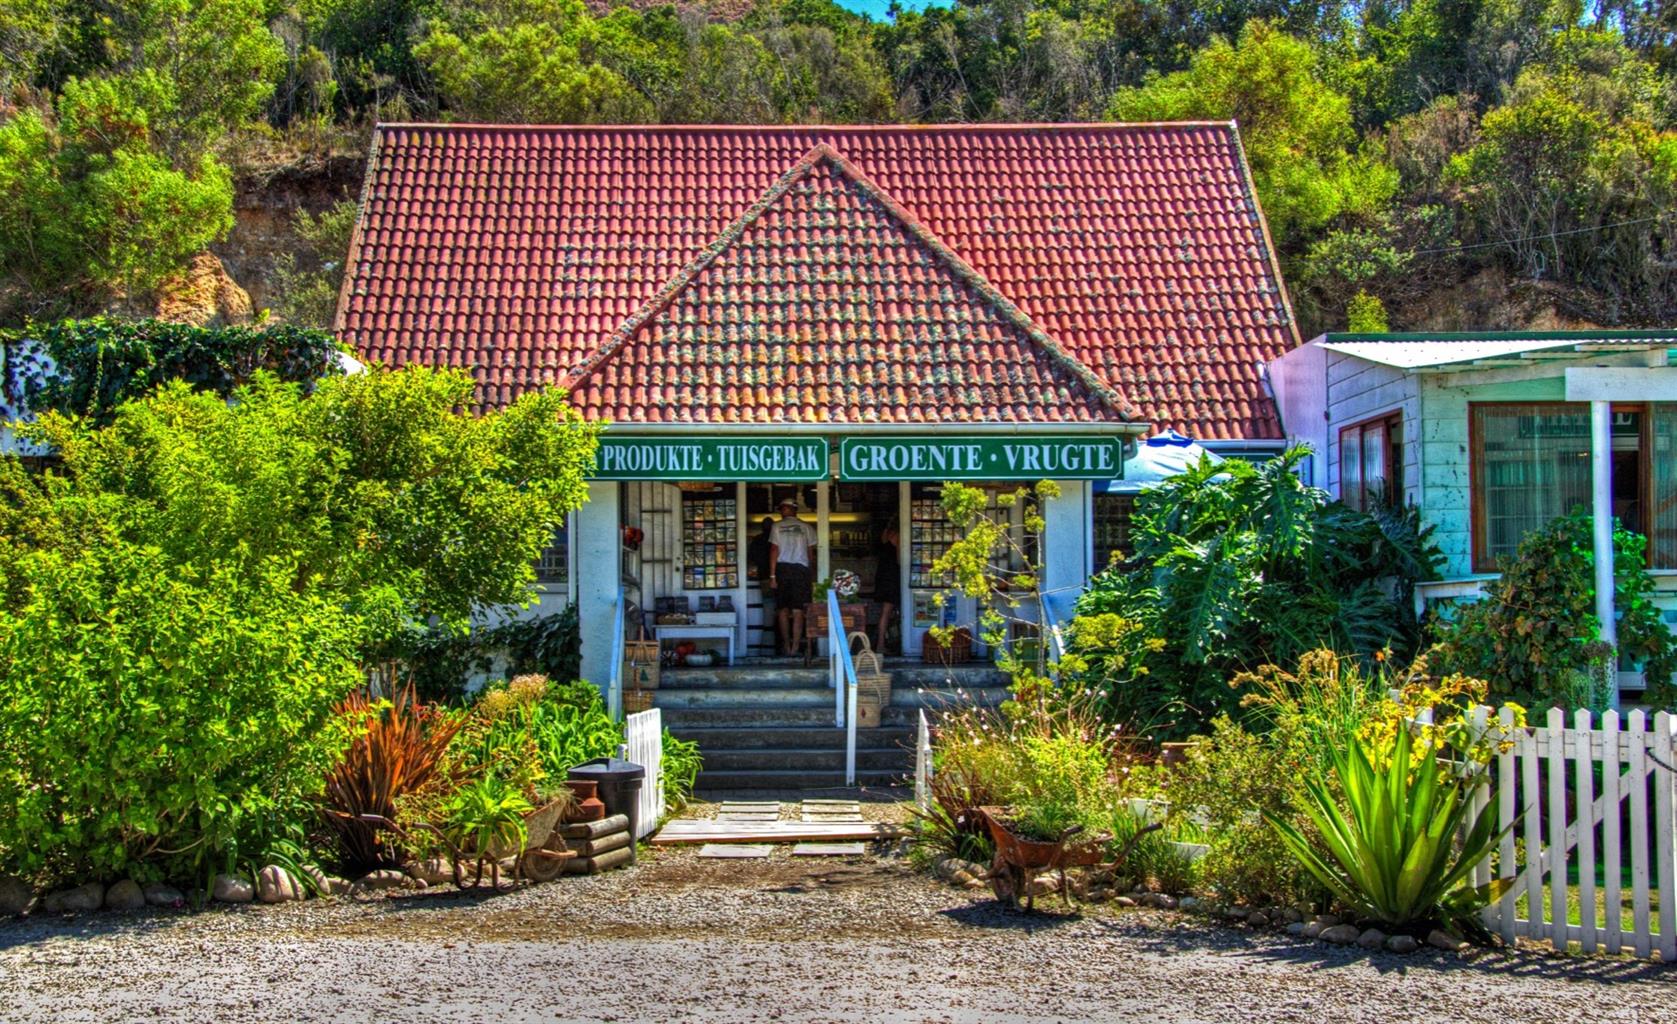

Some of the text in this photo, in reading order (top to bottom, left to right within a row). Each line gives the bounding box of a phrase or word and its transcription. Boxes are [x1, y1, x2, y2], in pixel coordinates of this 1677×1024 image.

[602, 445, 703, 471] PRODUKTE
[717, 445, 819, 471] TUISGEBAK
[849, 444, 1114, 470] GROENTE VRUGTE
